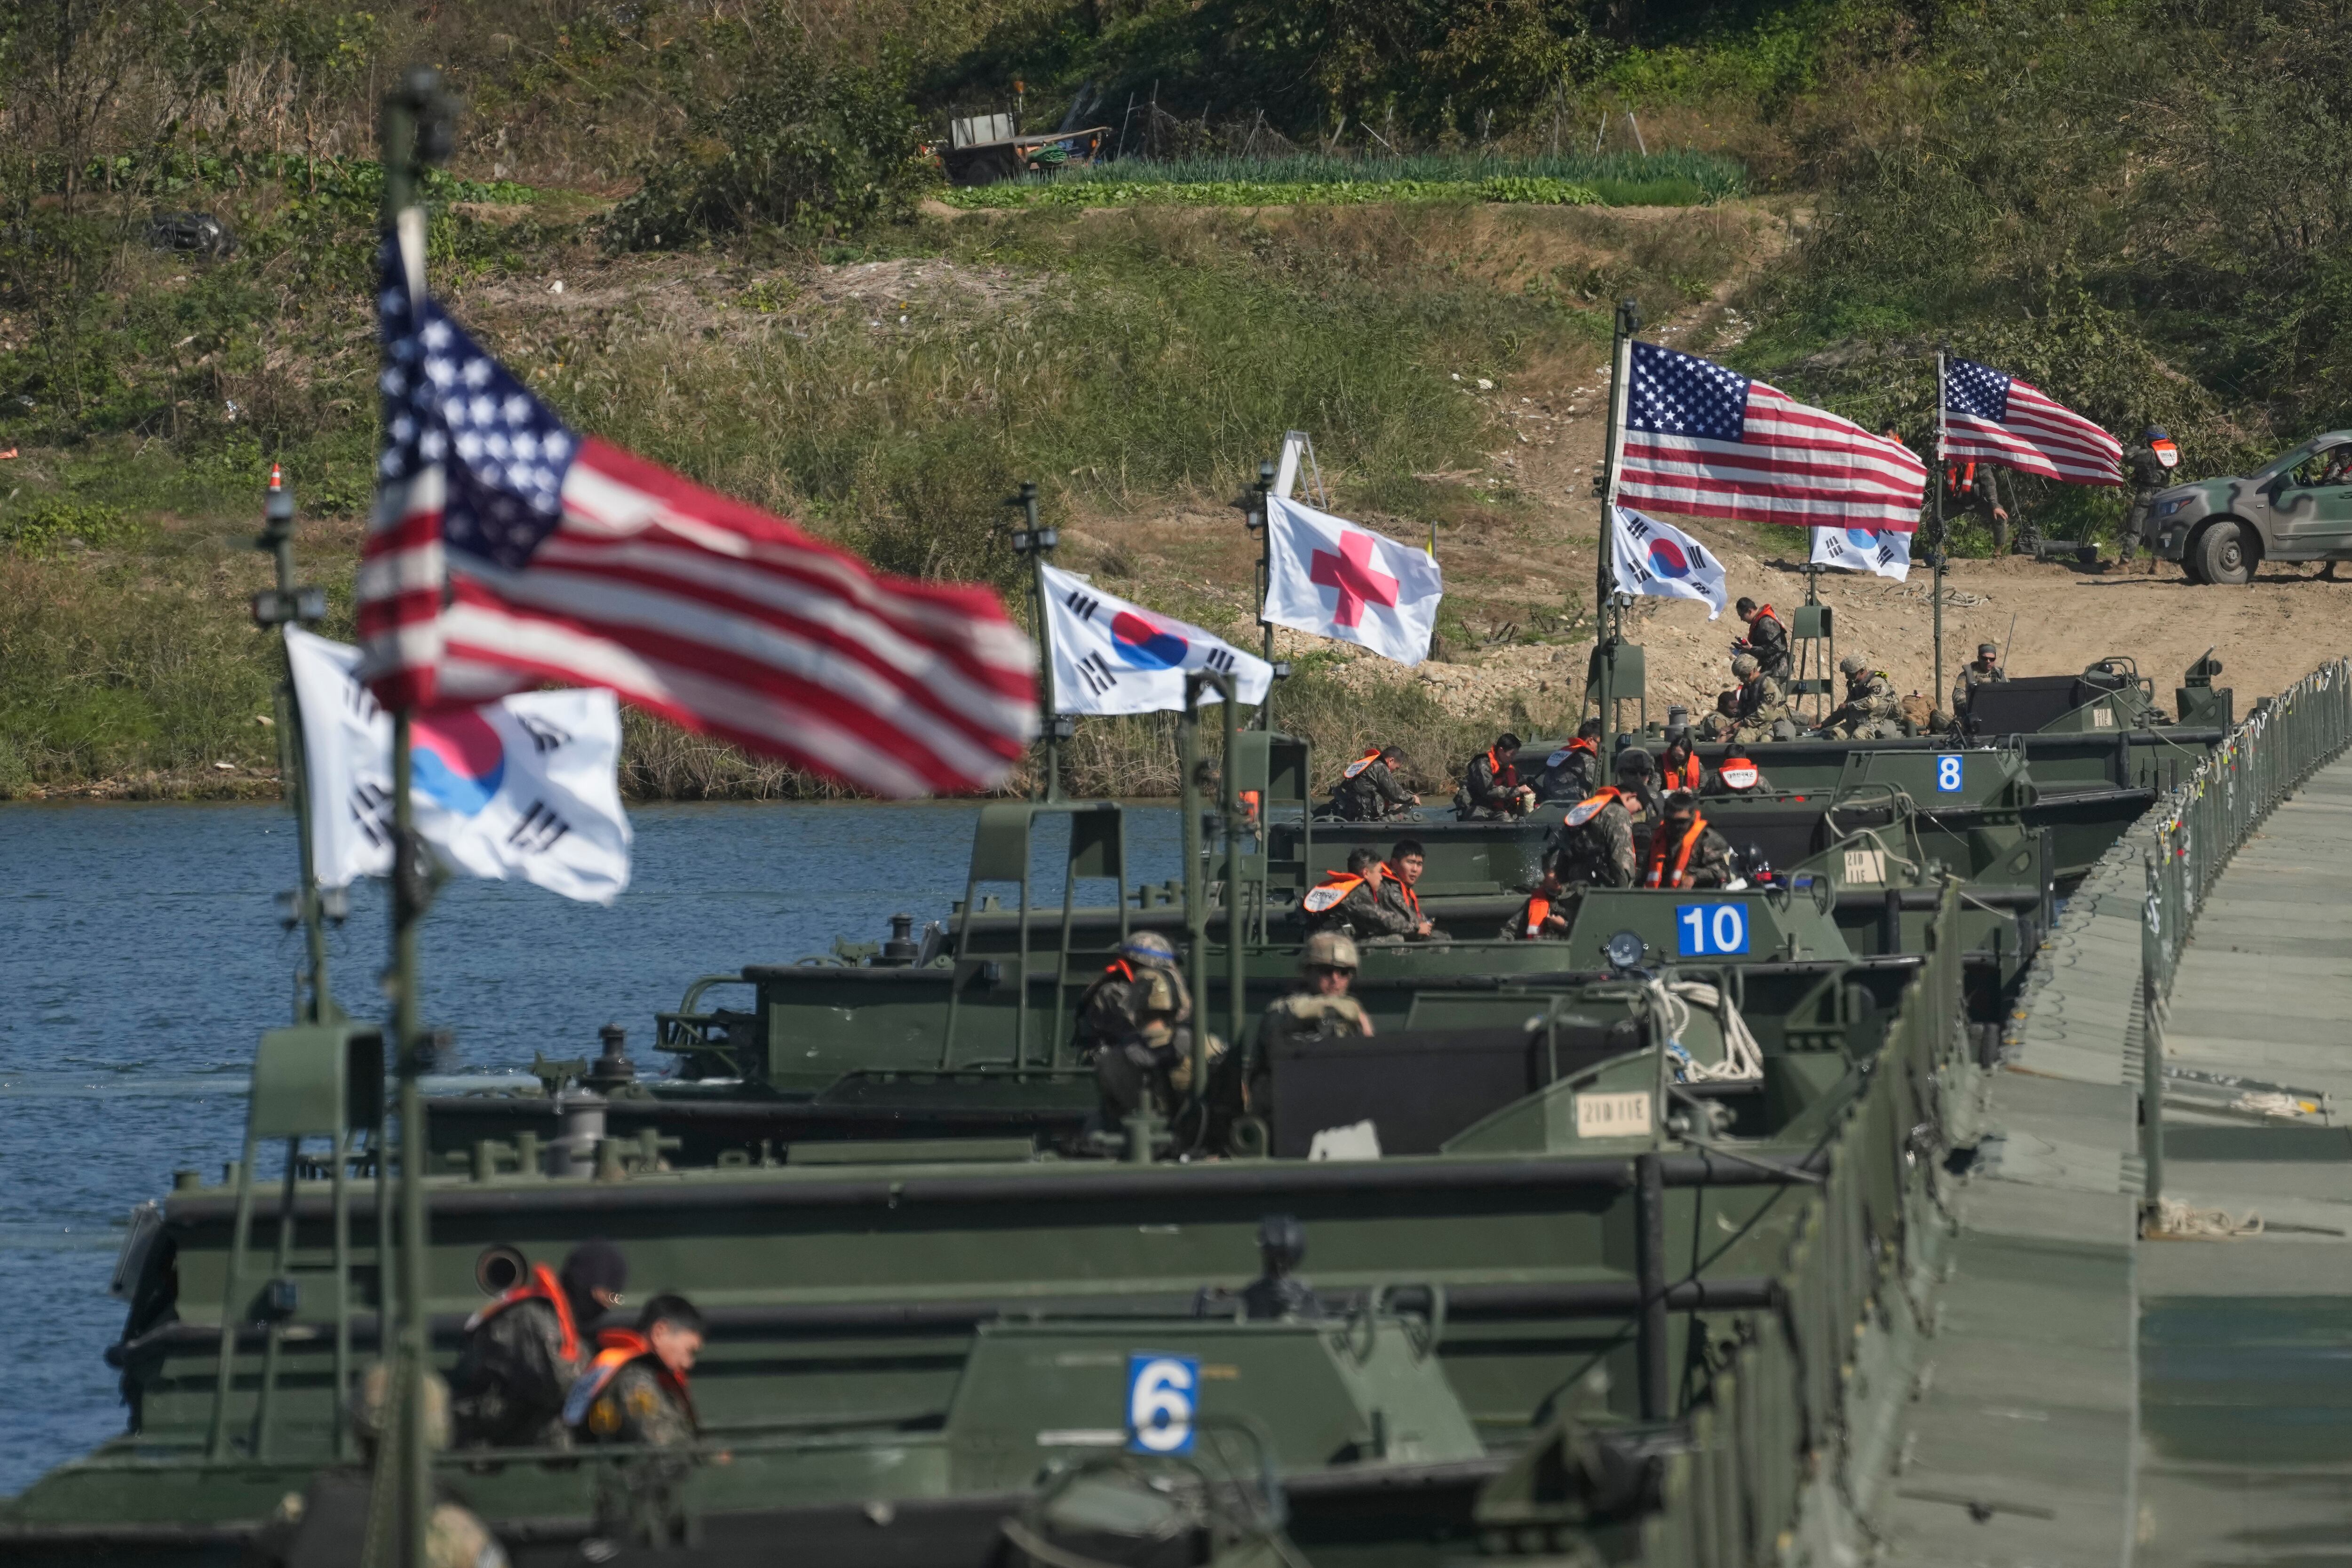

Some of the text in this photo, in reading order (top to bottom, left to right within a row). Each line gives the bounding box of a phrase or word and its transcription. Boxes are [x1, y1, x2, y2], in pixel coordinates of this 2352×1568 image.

[1939, 757, 1960, 790] 8
[1683, 905, 1743, 953] 10
[1131, 1358, 1193, 1452] 6
